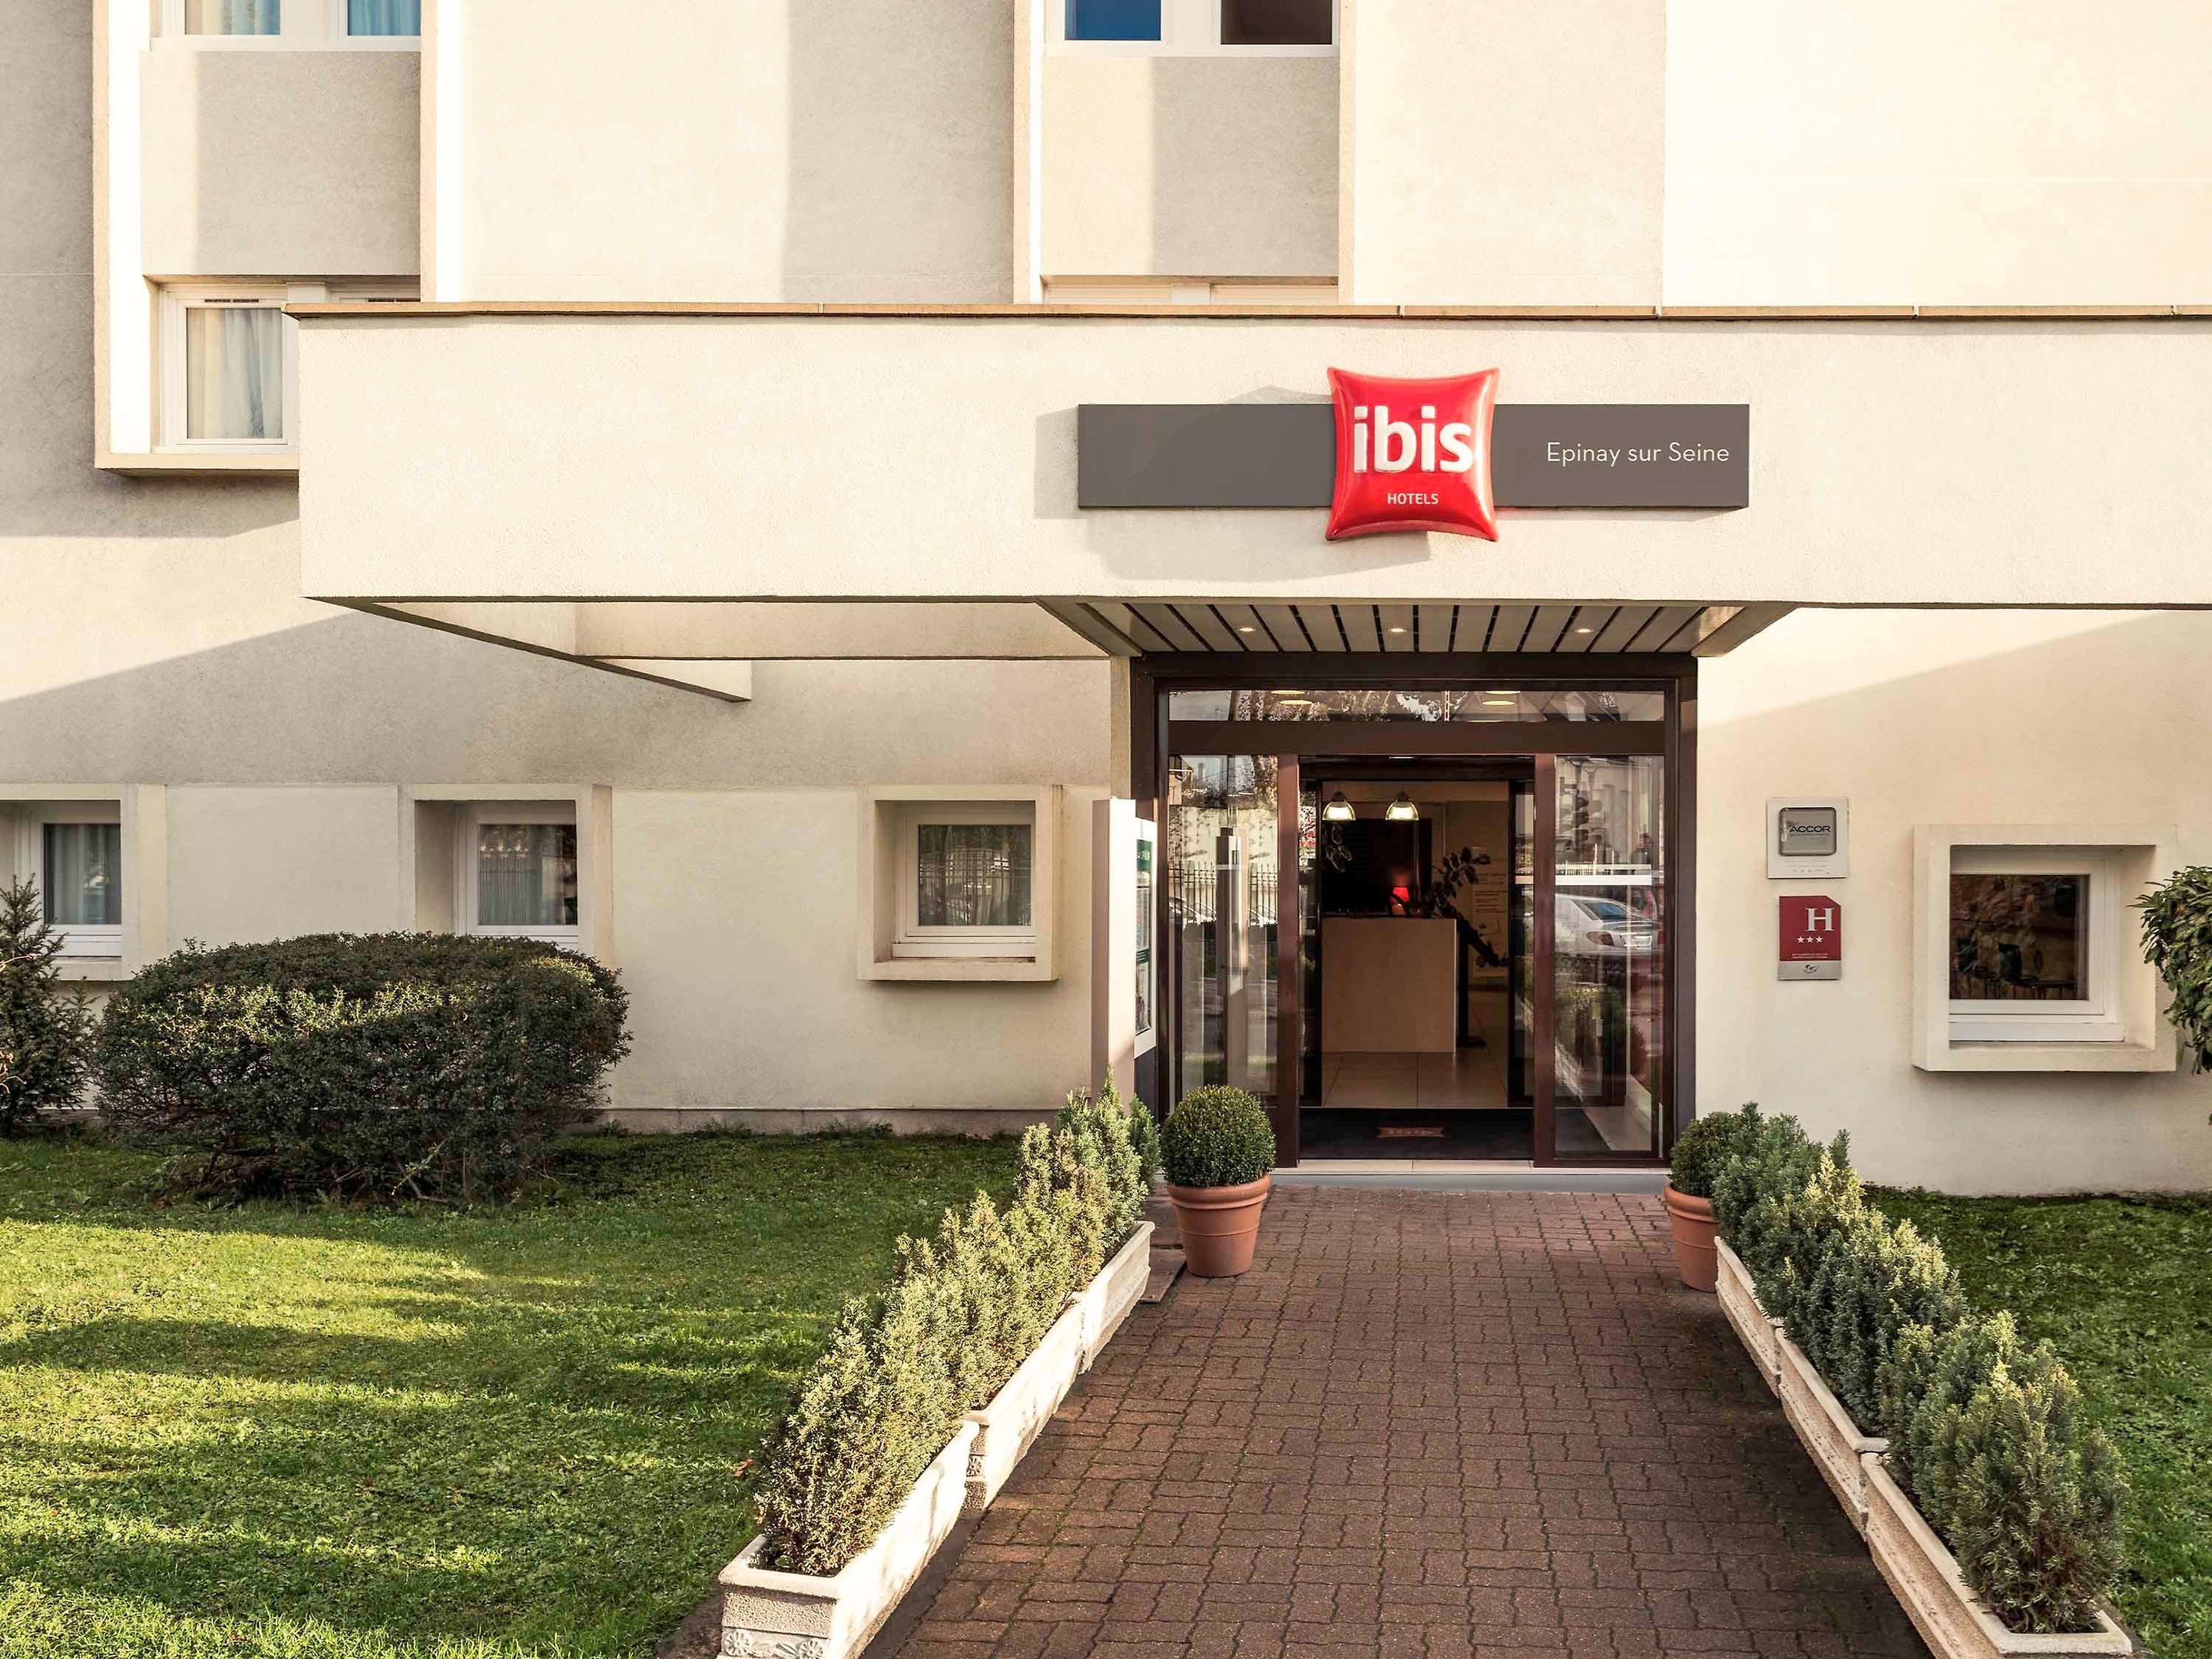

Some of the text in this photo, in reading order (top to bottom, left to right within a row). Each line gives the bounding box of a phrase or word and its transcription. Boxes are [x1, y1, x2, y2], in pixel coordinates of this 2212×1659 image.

[1353, 406, 1474, 473] ibis
[1547, 442, 1730, 467] Epinay sur Seine
[1387, 492, 1439, 505] HOTELS
[1805, 908, 1835, 931] H
